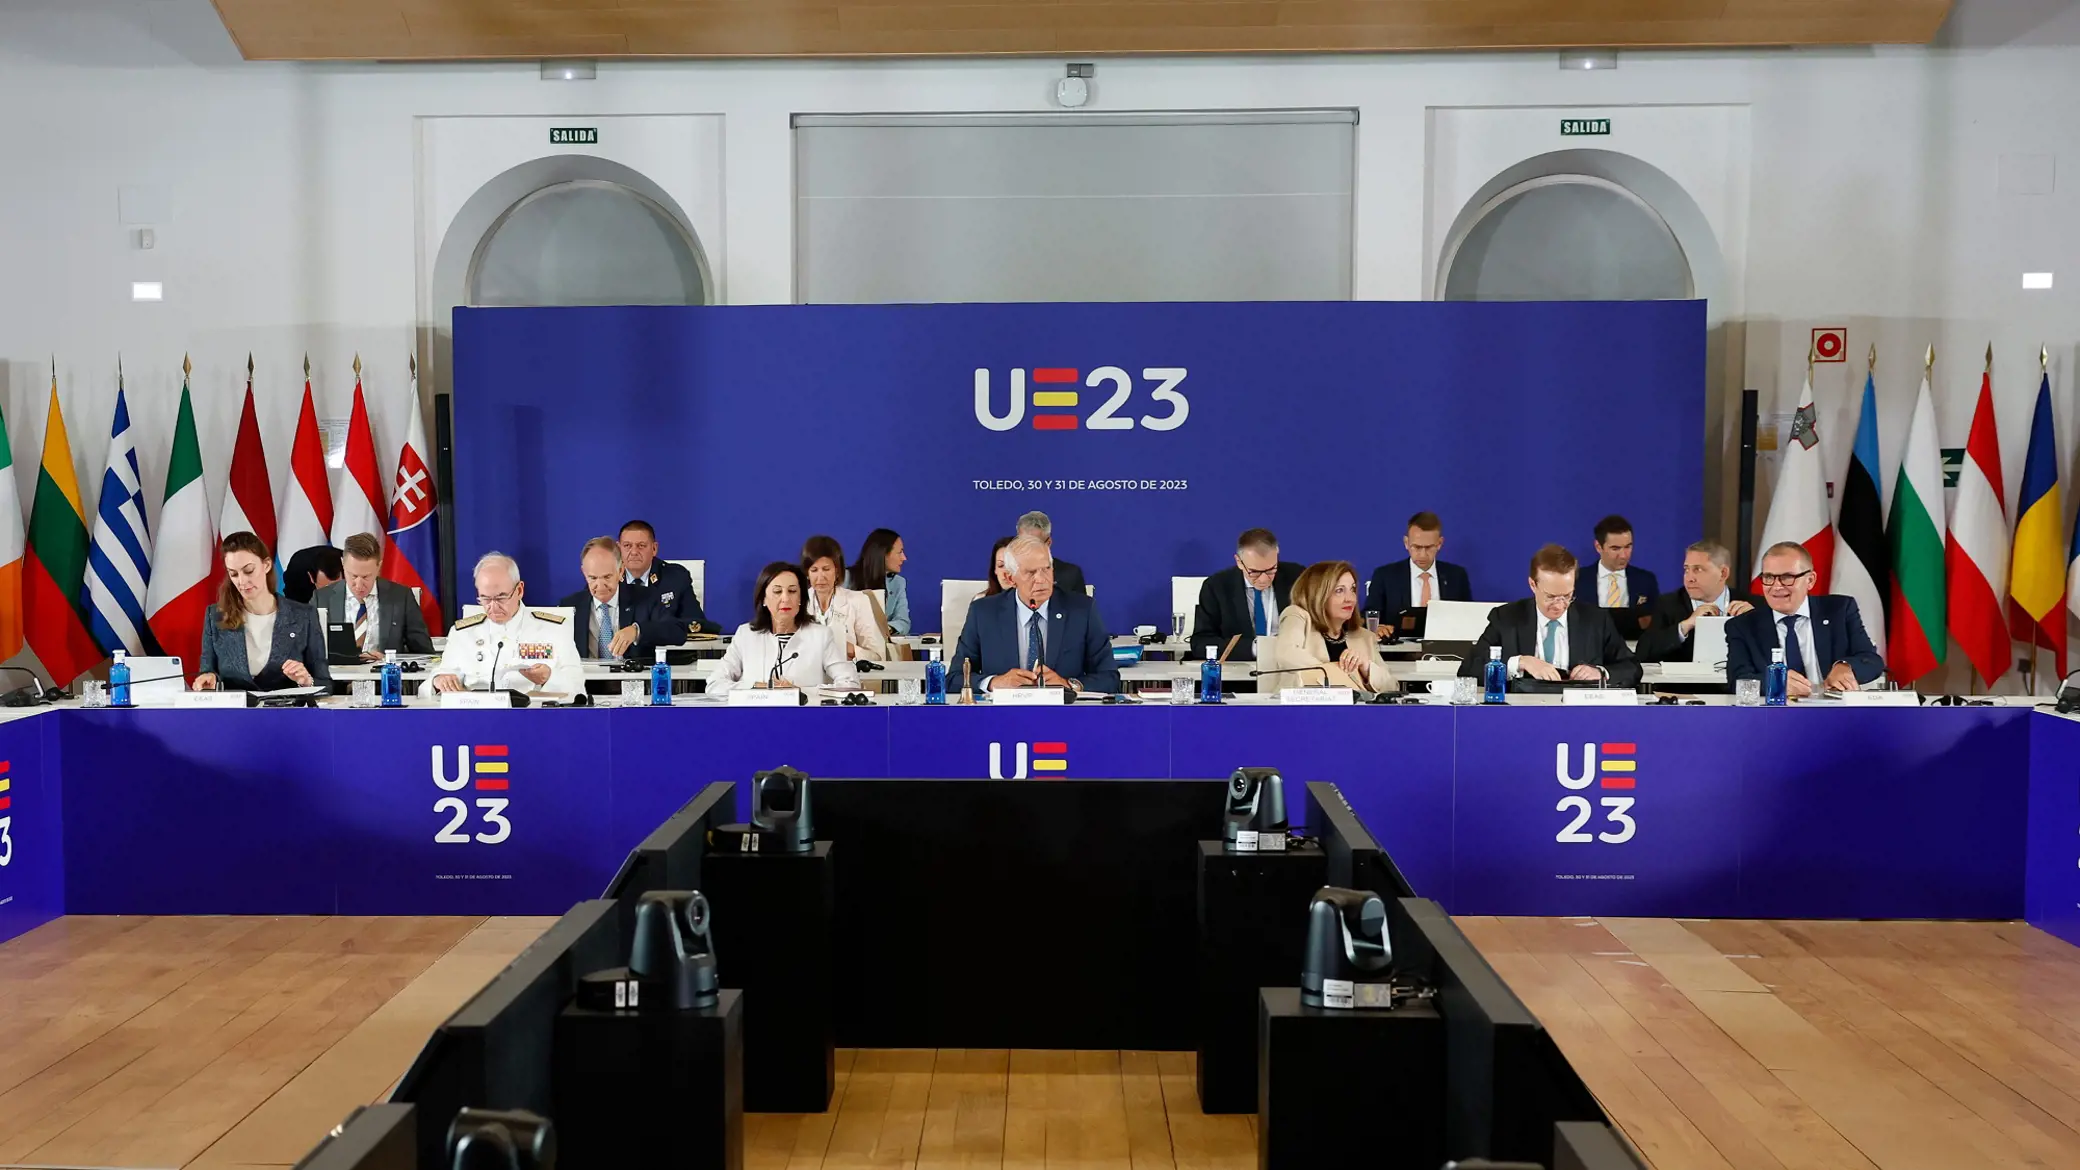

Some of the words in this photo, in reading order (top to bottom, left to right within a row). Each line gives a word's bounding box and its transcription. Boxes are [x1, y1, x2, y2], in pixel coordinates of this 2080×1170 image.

[553, 130, 594, 142] SALIDA
[1563, 121, 1607, 133] SALIDA
[974, 365, 1190, 431] UE23
[973, 480, 1025, 490] TOLEDO,
[1028, 480, 1042, 490] 30
[1044, 480, 1052, 490] Y
[1054, 480, 1066, 490] 31
[1069, 480, 1085, 490] DE
[1088, 480, 1138, 490] AGOSTO
[1141, 480, 1156, 490] DE
[1160, 480, 1188, 490] 2023
[431, 744, 510, 791] UE
[1556, 742, 1637, 790] UE
[433, 797, 512, 844] 23
[1556, 795, 1637, 844] 23
